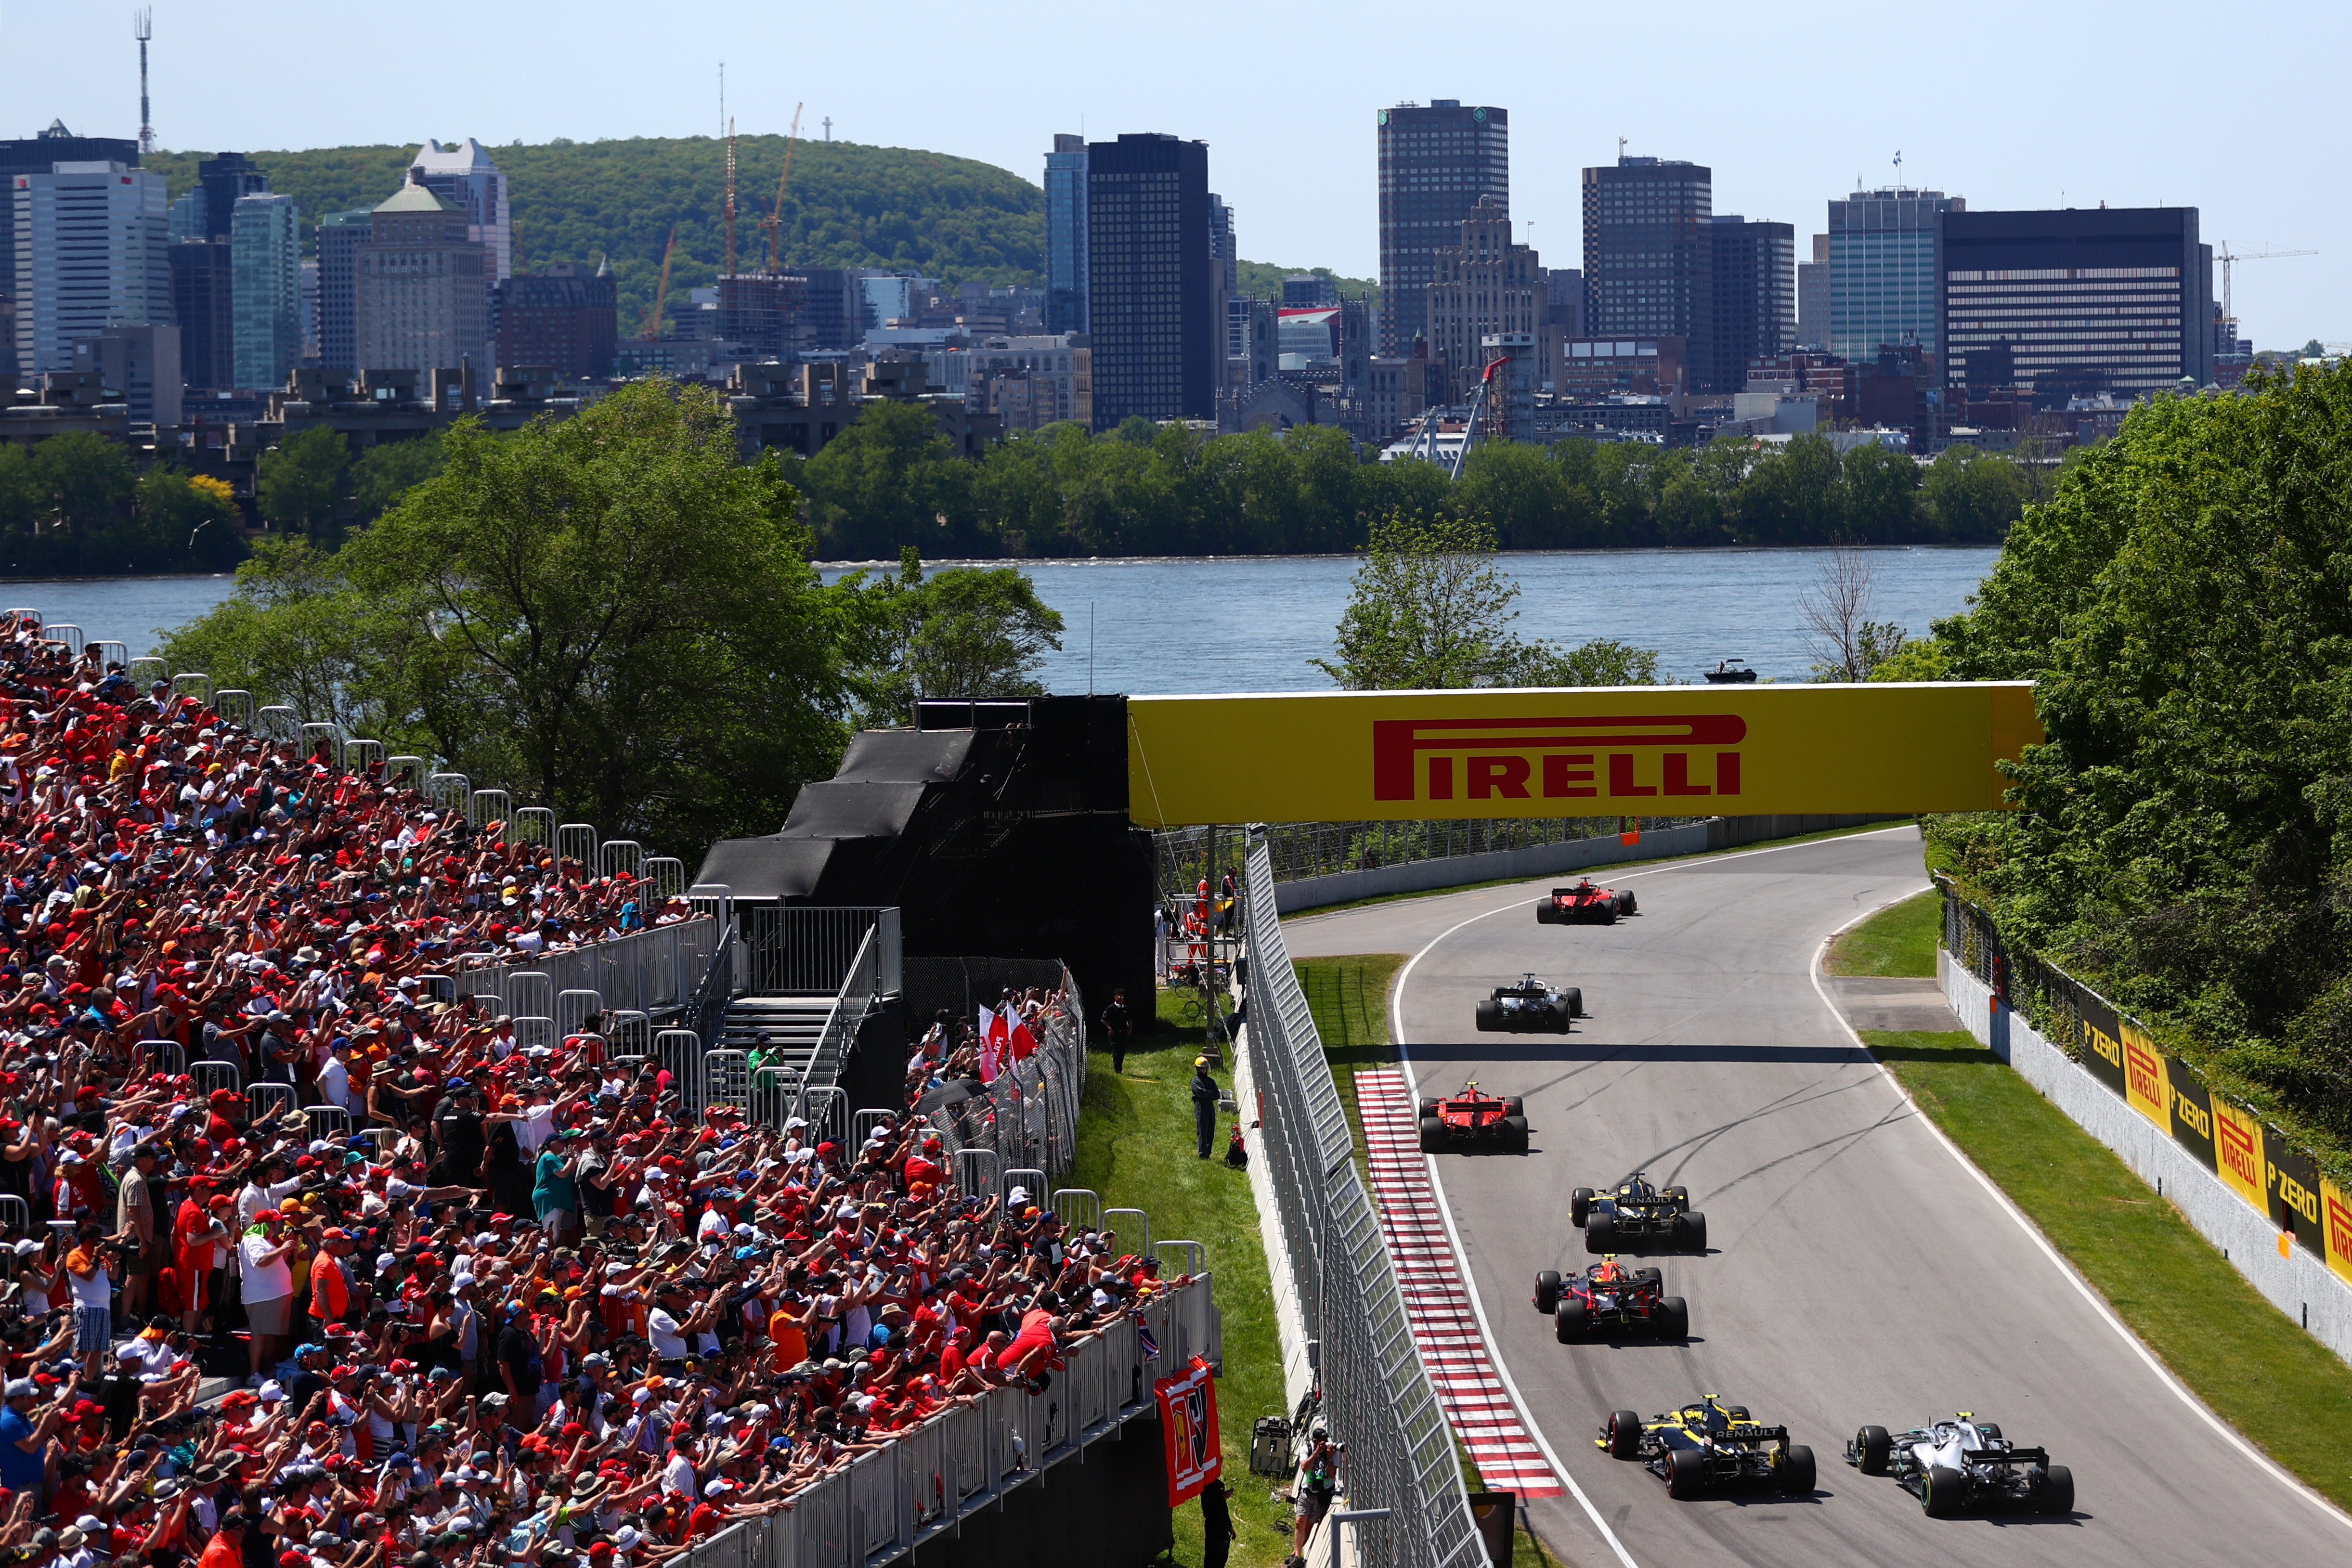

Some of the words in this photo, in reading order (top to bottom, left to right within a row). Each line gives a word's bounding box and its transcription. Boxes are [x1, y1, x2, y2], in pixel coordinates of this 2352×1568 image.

[1374, 714, 1746, 801] PIRELLI
[2083, 1019, 2091, 1044] P
[2092, 1025, 2120, 1068] ZERO
[2125, 1041, 2161, 1110] PIRELLI
[2170, 1083, 2176, 1109] P
[2177, 1090, 2209, 1140] ZERO
[2217, 1112, 2257, 1188] PIRELLI
[2268, 1160, 2276, 1189] P
[2278, 1169, 2317, 1224] ZERO
[1716, 1428, 1779, 1438] RENAULT
